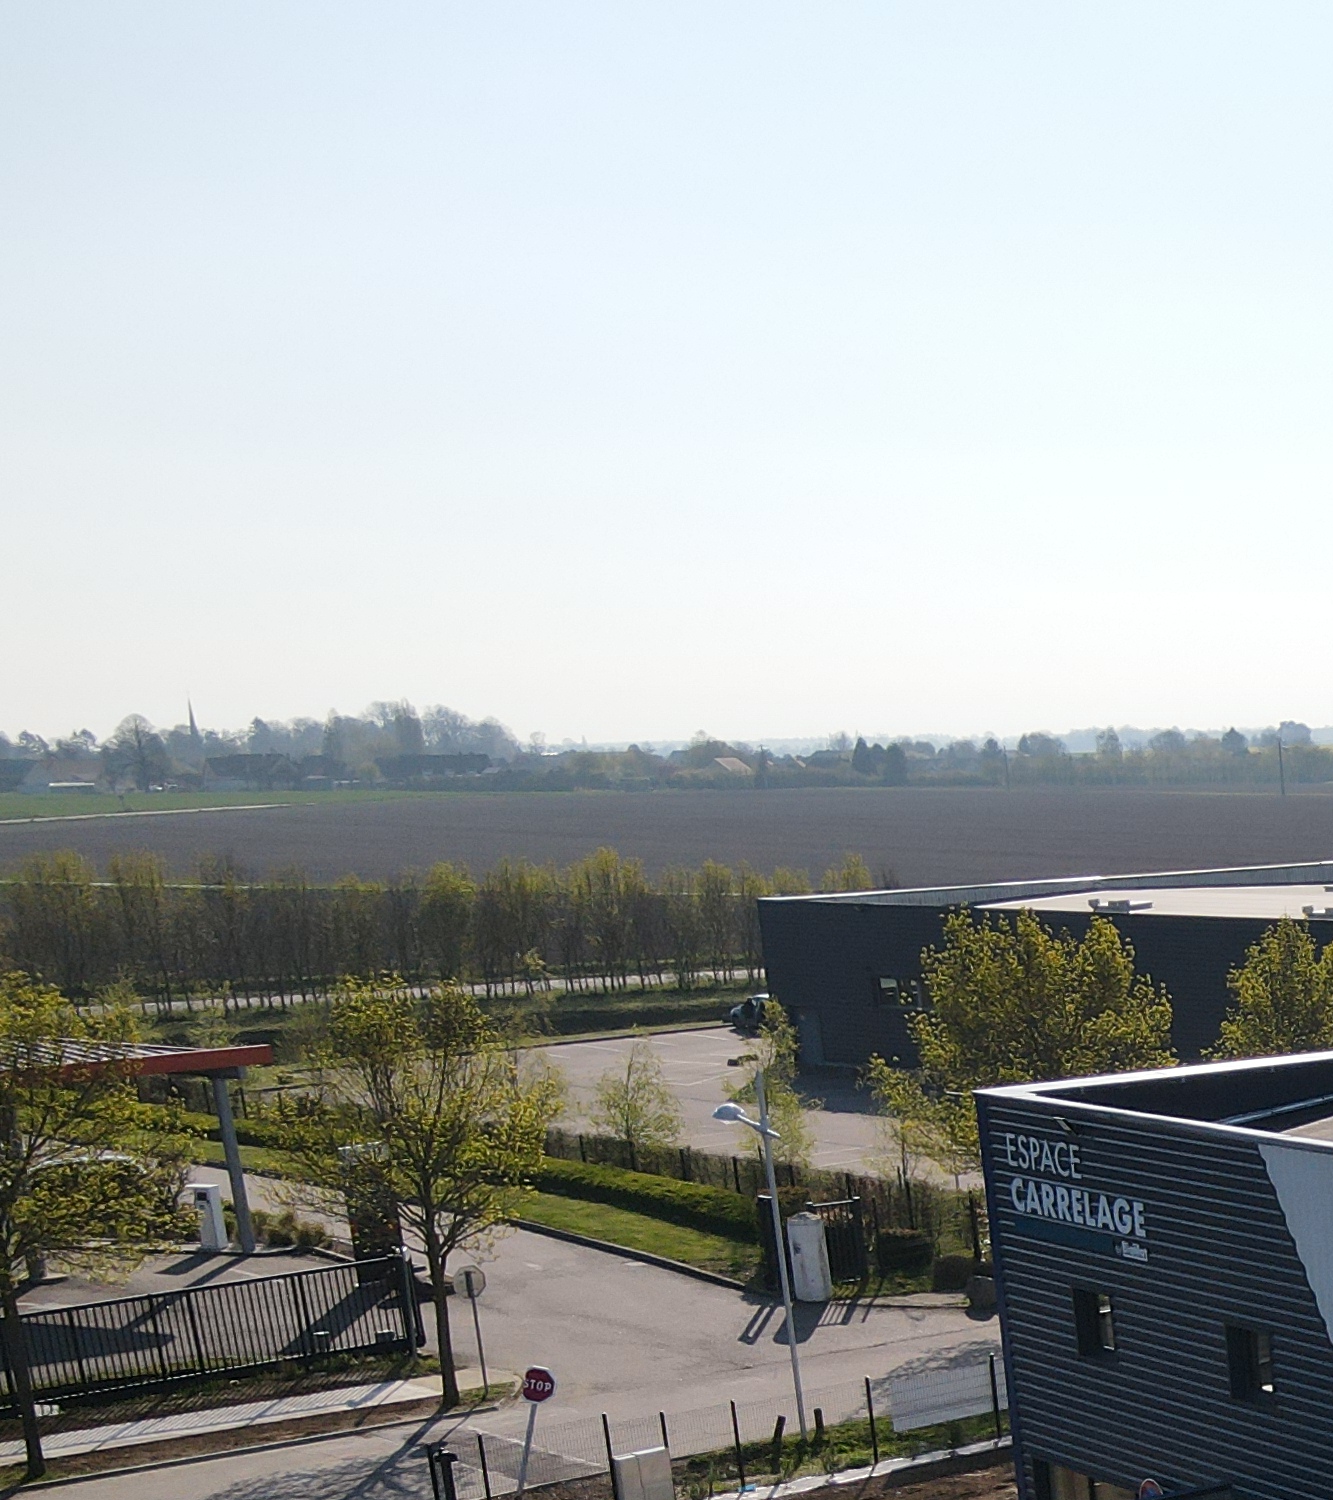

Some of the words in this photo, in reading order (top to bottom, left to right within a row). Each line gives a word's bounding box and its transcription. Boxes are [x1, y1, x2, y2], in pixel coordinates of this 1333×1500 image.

[1005, 1133, 1083, 1179] ESPACE
[1011, 1177, 1147, 1238] CARRELAGE
[523, 1379, 552, 1392] STOP
